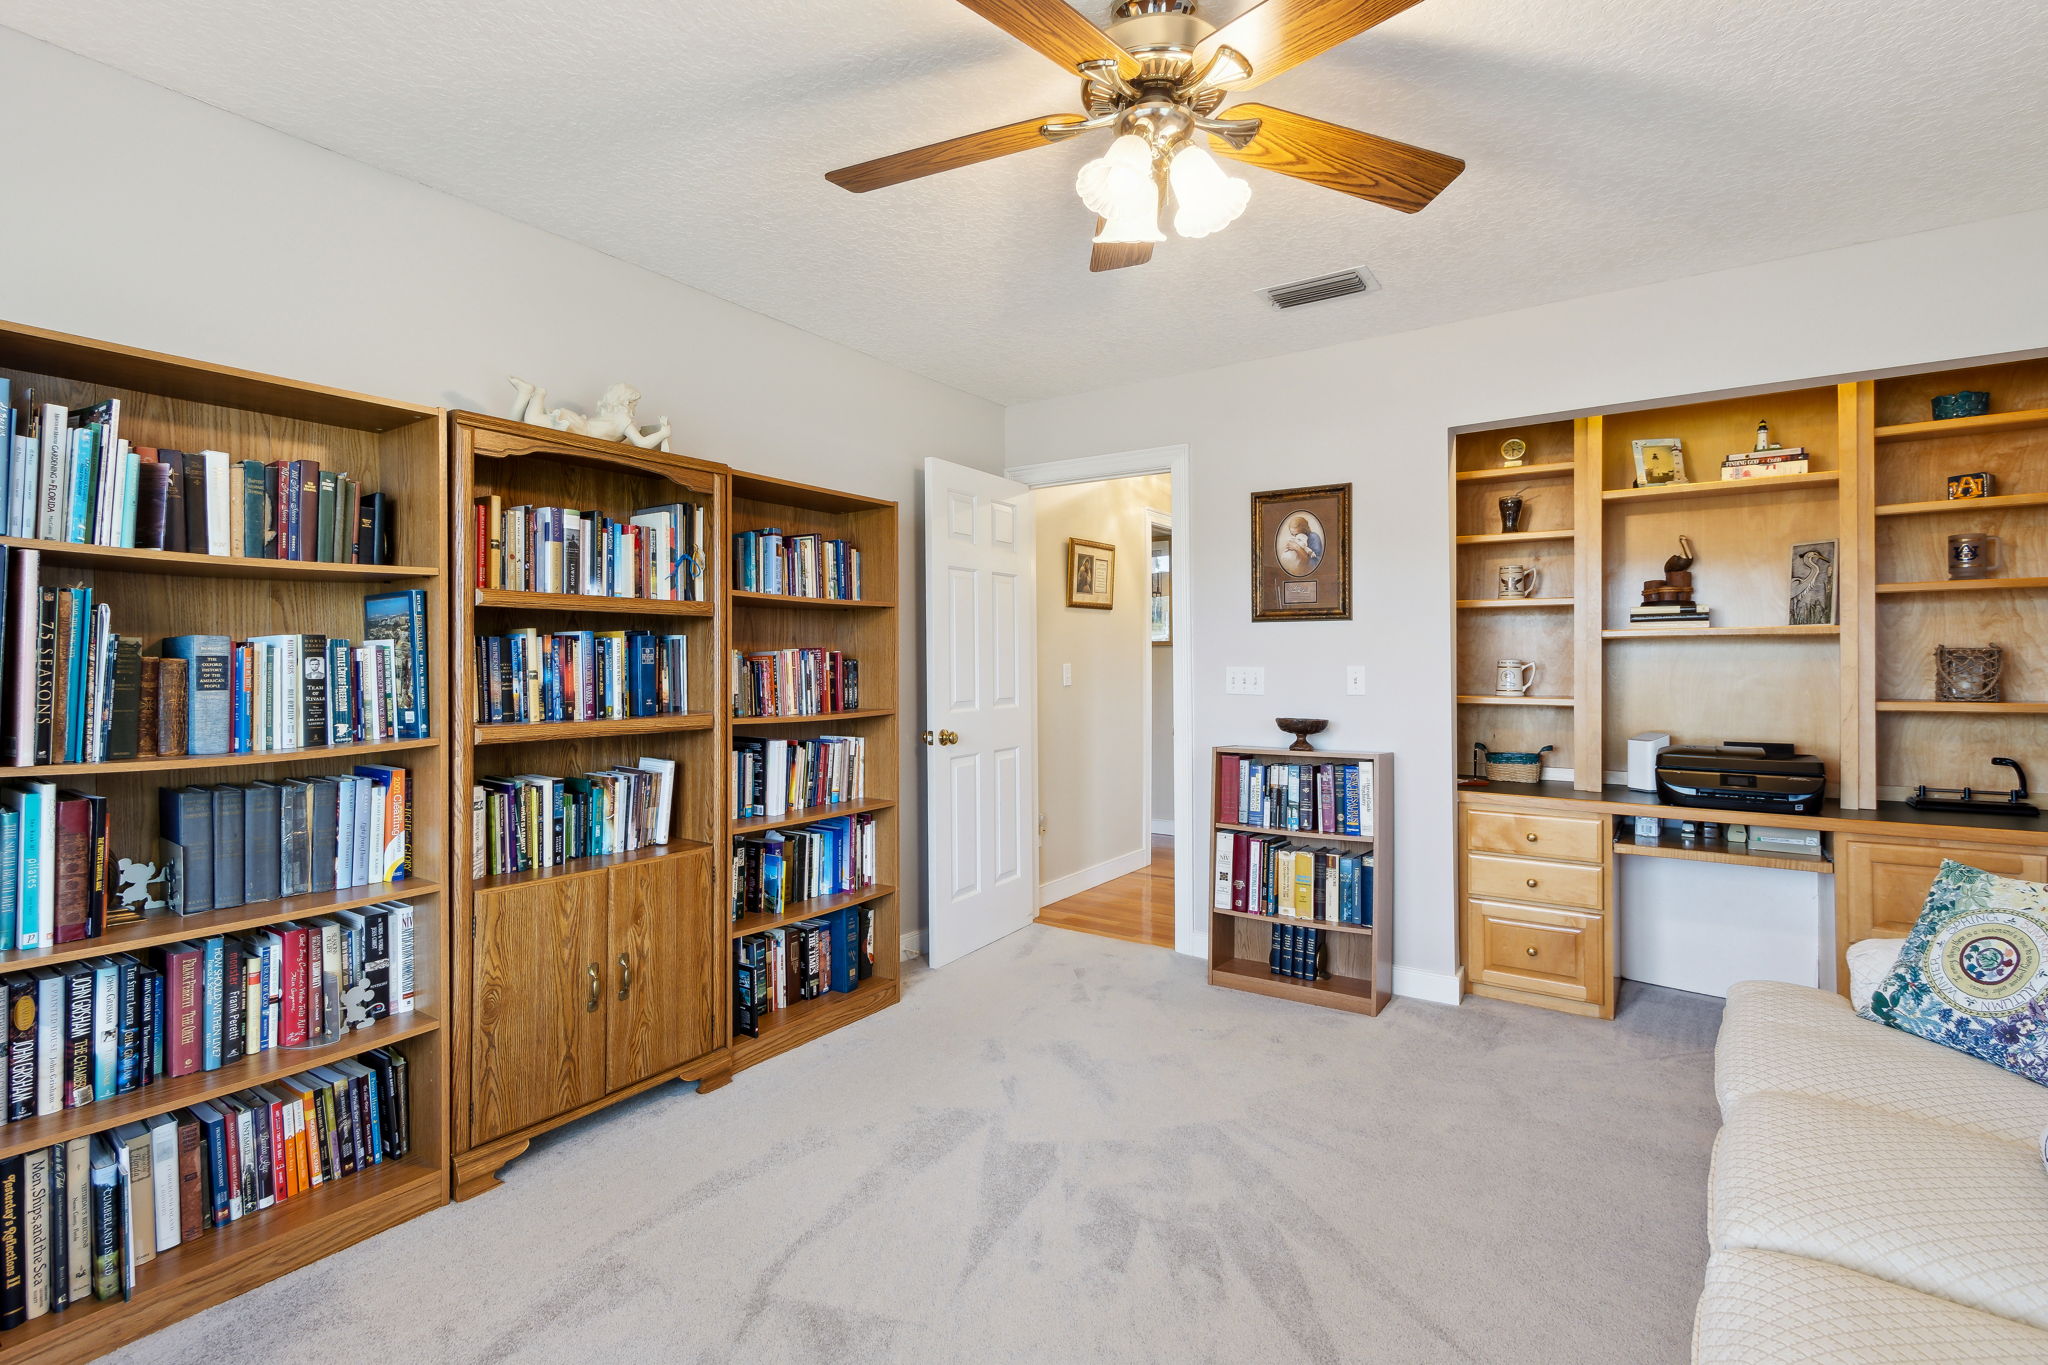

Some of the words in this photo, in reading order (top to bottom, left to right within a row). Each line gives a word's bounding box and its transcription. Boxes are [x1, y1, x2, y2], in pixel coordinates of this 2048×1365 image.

[50, 445, 59, 478] GARDENING
[47, 484, 58, 513] FLORIDA
[40, 622, 55, 640] 75
[337, 647, 348, 666] BATTLE
[337, 667, 347, 677] CRY
[37, 648, 54, 725] SEASONS
[306, 685, 324, 694] TEAM
[338, 686, 348, 711] FREEDOM
[393, 777, 401, 793] 2001
[392, 795, 402, 836] Cleaning
[1351, 788, 1359, 823] THESAURUS
[2, 824, 16, 838] THE
[404, 809, 412, 831] LIGHT
[404, 844, 412, 871] GLORY
[27, 858, 39, 888] pilates
[2, 895, 16, 913] DIET
[1948, 914, 1999, 934] SPRING
[327, 936, 332, 944] OF
[213, 948, 223, 967] HOW
[230, 952, 240, 985] monster
[128, 966, 137, 980] THE
[182, 958, 197, 981] FRANK
[263, 965, 271, 983] ISRAEL
[1930, 954, 1957, 1000] WINTER
[73, 977, 91, 998] JOHN
[105, 974, 116, 993] JOHN
[126, 981, 136, 1002] STREET
[182, 980, 195, 1008] PERETTI
[212, 969, 222, 1000] SHOULD
[263, 985, 270, 993] OF
[50, 990, 58, 1024] PAINTED
[230, 991, 241, 1012] Frank
[263, 993, 271, 1008] GOD
[1981, 982, 2037, 1010] AUTUMN
[72, 999, 91, 1038] GRISHAM
[105, 994, 115, 1024] GRISHAM
[126, 1002, 135, 1026] LAWYER
[182, 1010, 196, 1027] THE
[213, 1001, 222, 1015] WE
[182, 1026, 196, 1046] OATH
[213, 1016, 222, 1036] THEN
[229, 1014, 240, 1041] Peretti
[74, 1039, 88, 1055] THE
[122, 1028, 138, 1047] JOHN
[213, 1037, 221, 1057] LIVE?
[14, 1040, 34, 1062] JOHN
[12, 1063, 33, 1102] GRISHAM
[73, 1055, 87, 1090] CHAMBER
[49, 1074, 57, 1103] Grisham
[31, 1160, 46, 1190] Men,
[133, 1154, 142, 1177] Florida
[2, 1174, 16, 1226] Yesterday's
[28, 1190, 45, 1224] Ships,
[102, 1189, 113, 1244] CUMBERLAND
[33, 1224, 46, 1245] and
[3, 1226, 18, 1276] Reflections
[33, 1244, 46, 1263] the
[105, 1246, 113, 1276] ISLAND
[6, 1275, 20, 1289] II
[33, 1263, 46, 1287] Sea
